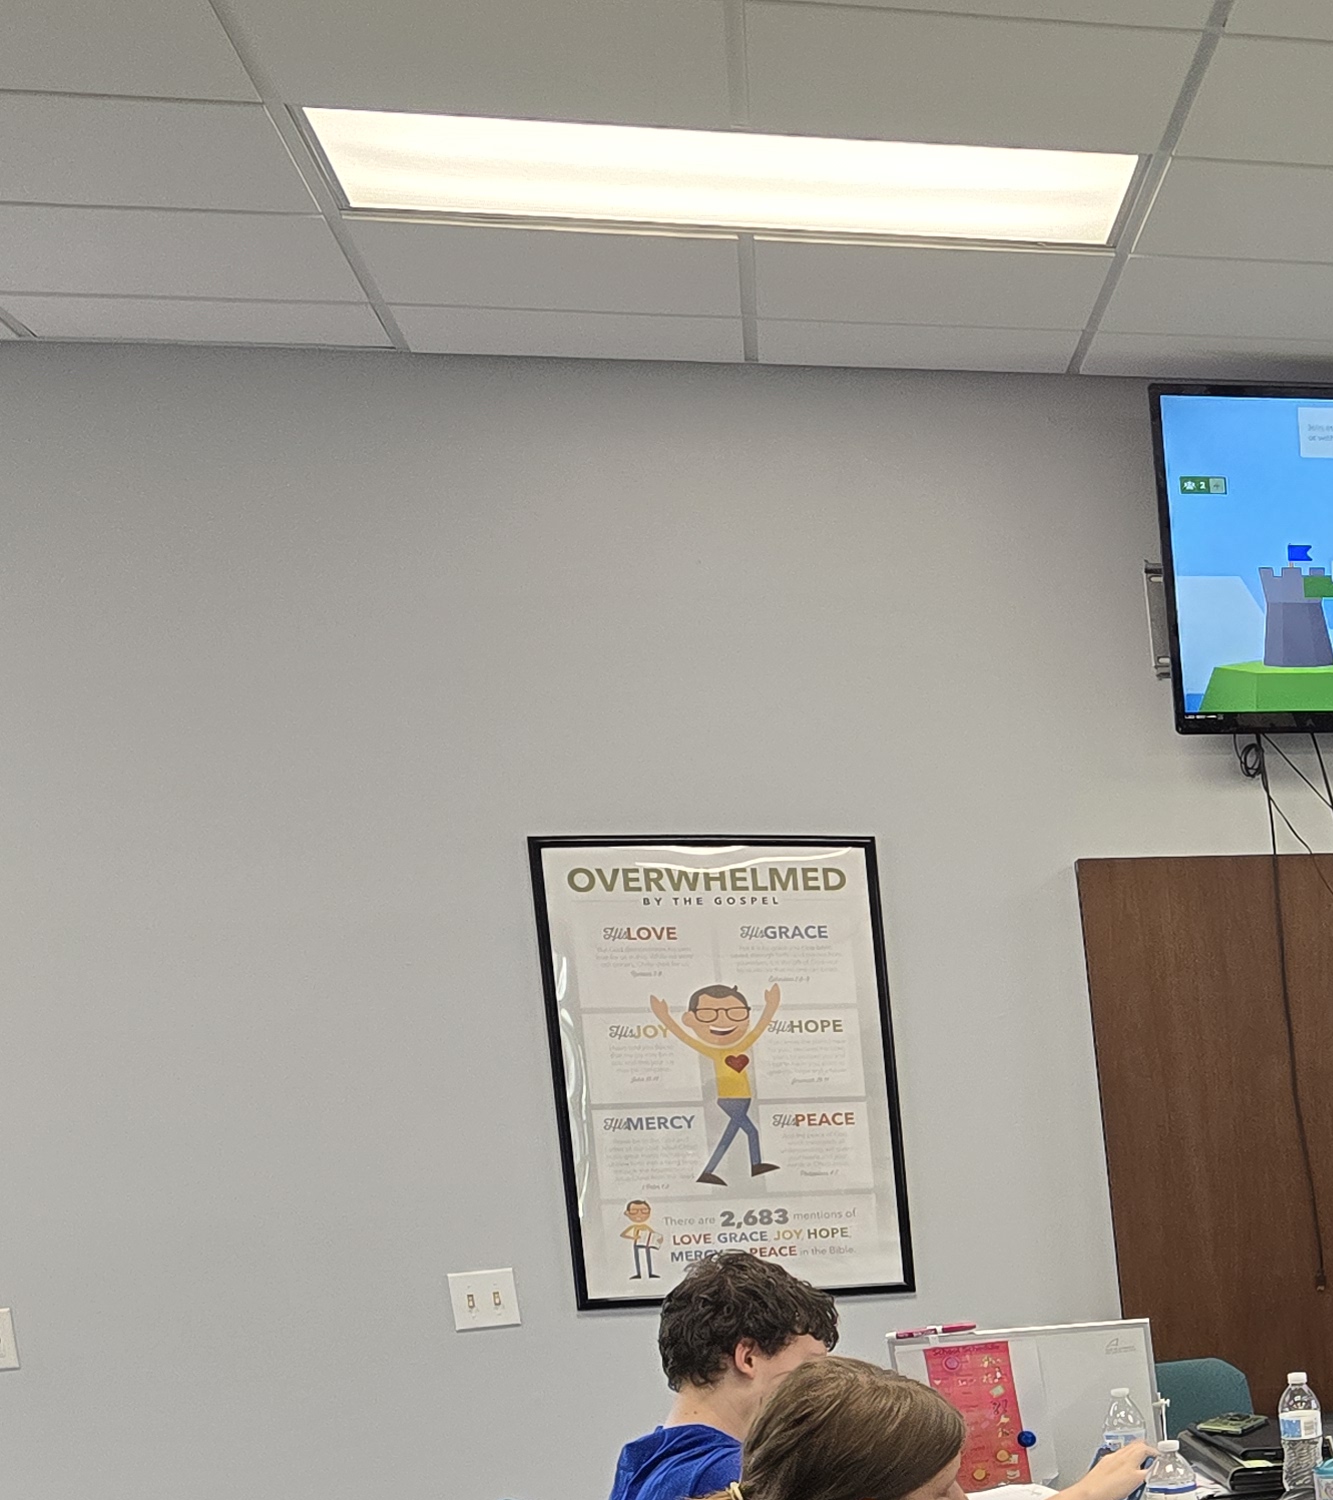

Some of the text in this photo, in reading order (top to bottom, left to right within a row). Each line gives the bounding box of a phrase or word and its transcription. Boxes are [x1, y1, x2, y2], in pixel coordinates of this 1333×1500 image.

[1200, 481, 1206, 490] 2
[567, 868, 846, 893] OVERWHELMED
[642, 896, 779, 906] BY THE GOSPEL
[627, 926, 678, 940] LOVE
[764, 925, 828, 939] GRACE
[634, 1025, 668, 1039] JOY
[790, 1020, 843, 1033] HOPE
[627, 1115, 695, 1130] MERCY
[795, 1112, 855, 1126] PEACE
[664, 1209, 856, 1229] There are 2,683 mentions of
[750, 1246, 797, 1258] PEACE
